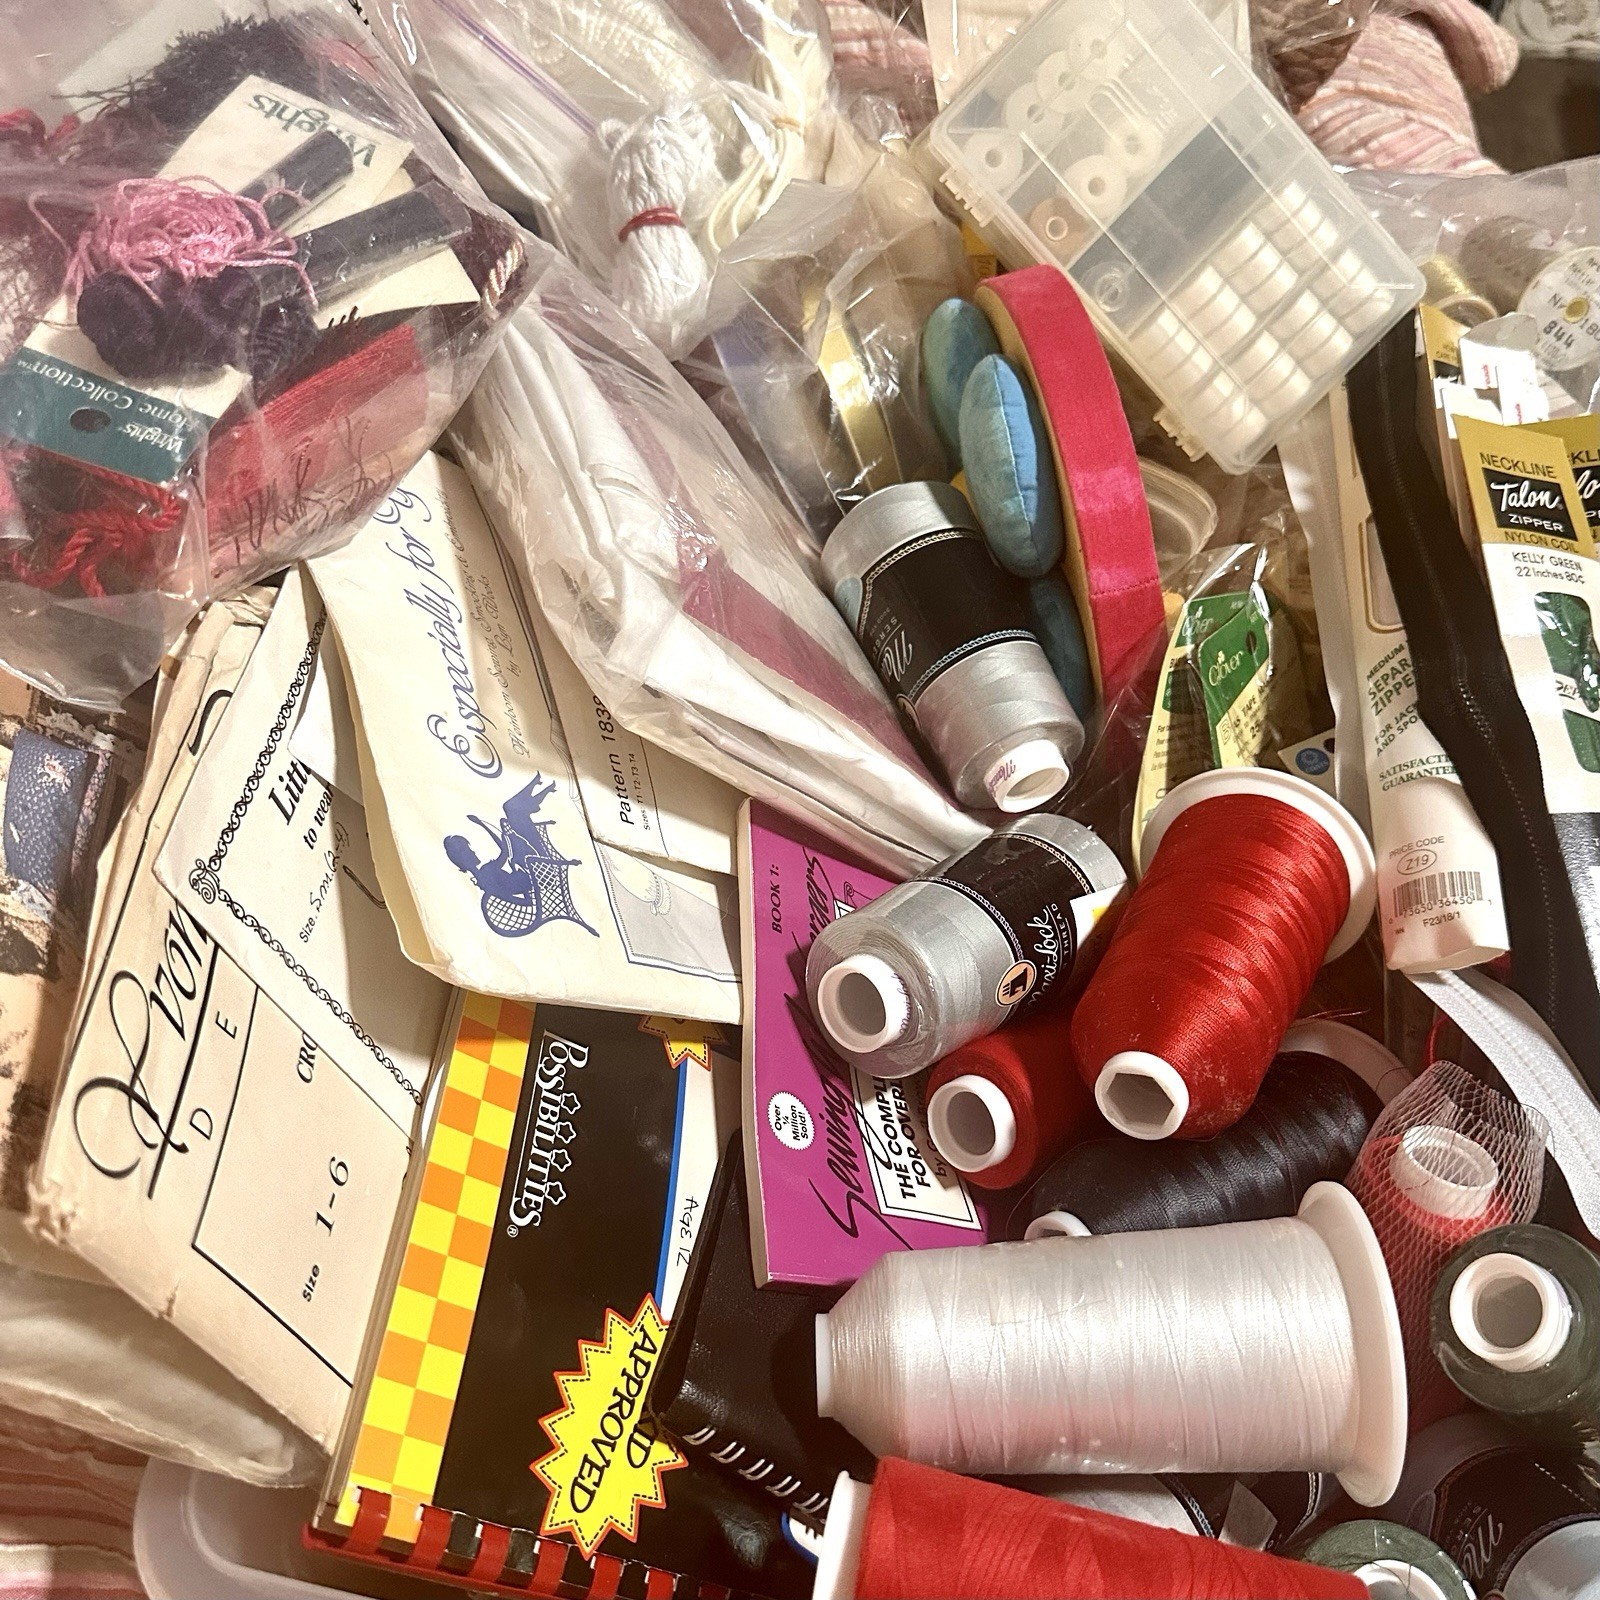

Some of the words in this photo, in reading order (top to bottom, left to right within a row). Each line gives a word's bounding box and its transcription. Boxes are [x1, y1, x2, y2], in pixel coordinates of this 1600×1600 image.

[248, 93, 377, 168] Wghts
[1542, 320, 1575, 349] 844
[123, 420, 185, 454] Wrights
[1479, 452, 1558, 479] NECKLINE
[1490, 480, 1560, 512] Talon
[1507, 513, 1564, 533] ZIPPER
[1504, 530, 1549, 547] NYLON
[1550, 538, 1580, 554] COIL
[385, 526, 455, 595] for
[1511, 551, 1545, 565] KELLY
[1549, 555, 1583, 573] GREEN
[1514, 565, 1532, 578] 22
[1533, 567, 1565, 581] Inches
[493, 622, 515, 658] Lyn
[506, 659, 522, 678] by
[1208, 651, 1244, 687] Clover
[1366, 642, 1405, 682] MEDIUM
[1367, 657, 1412, 701] SEPAR
[403, 582, 503, 779] Especially
[1371, 673, 1415, 717] ZIPPE
[501, 690, 531, 758] Heirloom
[1241, 695, 1257, 719] TAPE
[1374, 722, 1393, 745] FOR
[1376, 732, 1396, 757] AND
[1396, 714, 1419, 735] SPO
[608, 753, 635, 825] Pattern
[303, 827, 318, 850] to
[313, 782, 334, 827] wear
[640, 804, 652, 831] Sizes:
[1389, 842, 1414, 859] PRICE
[1415, 835, 1445, 848] CODE
[1405, 853, 1430, 871] Z19
[769, 881, 783, 935] BOOK
[1402, 901, 1434, 918] 73650
[1437, 895, 1474, 909] 36450
[1422, 910, 1462, 928] F23/18/1
[1050, 903, 1070, 955] THREAD
[774, 1104, 782, 1132] Over
[792, 1104, 802, 1141] Million
[801, 1111, 809, 1140] Sold!
[872, 1076, 905, 1156] COMPL
[808, 1074, 914, 1251] Sewing
[893, 1161, 917, 1200] THE
[907, 1148, 931, 1188] FOR
[934, 1157, 948, 1178] by
[679, 1195, 700, 1240] AGE
[570, 1323, 658, 1514] APPROVED
